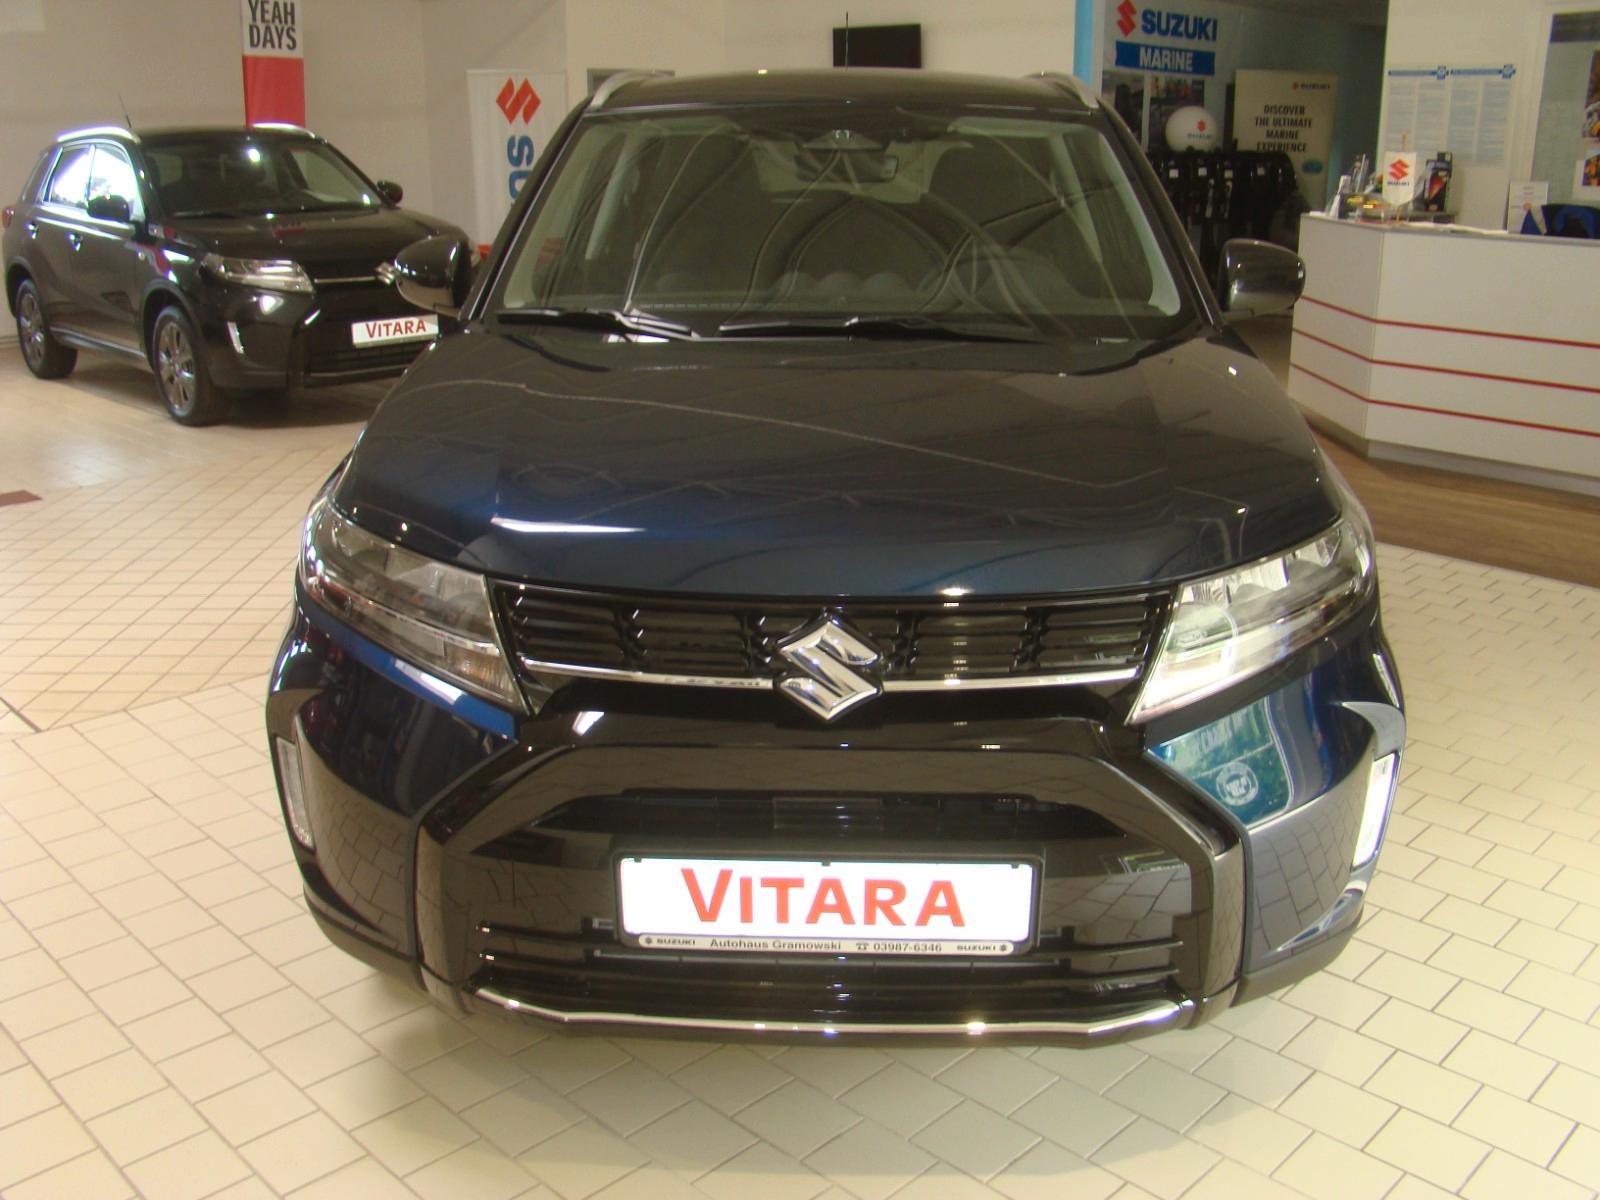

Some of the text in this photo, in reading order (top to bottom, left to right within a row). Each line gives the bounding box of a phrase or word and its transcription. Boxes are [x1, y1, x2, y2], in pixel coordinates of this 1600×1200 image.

[248, 0, 295, 25] YEAH
[1141, 9, 1218, 41] SUZUKI
[249, 24, 297, 50] DAYS
[1139, 47, 1194, 72] MARINE
[1263, 104, 1305, 115] DISCOVER
[1255, 117, 1312, 128] THE ULTIMATE
[1265, 130, 1299, 140] MARINE
[1256, 142, 1307, 153] EXPERIENCE
[365, 319, 427, 338] VITARA
[680, 867, 965, 928] VITARA
[656, 938, 997, 953] SUZUKI Autohaus Gramowski 03987-6346 SUZUKI
